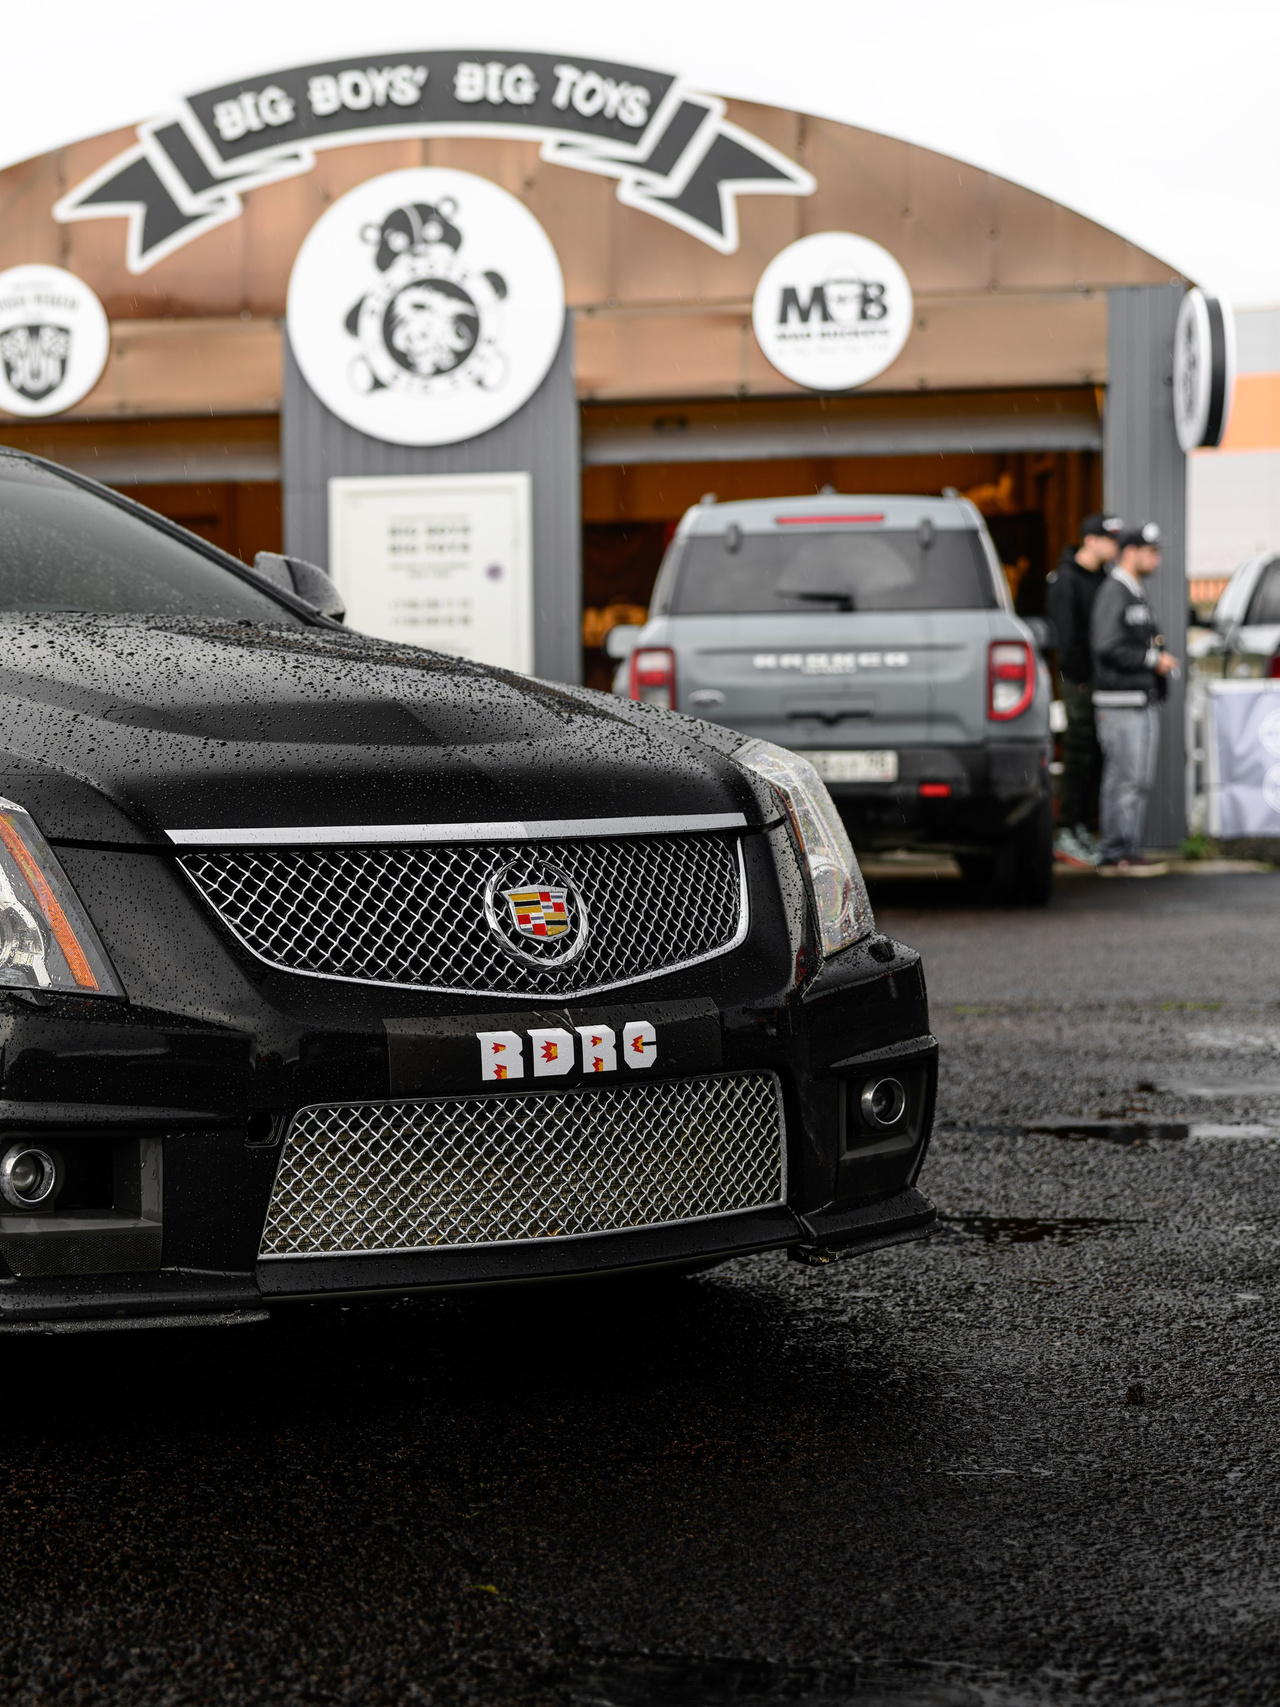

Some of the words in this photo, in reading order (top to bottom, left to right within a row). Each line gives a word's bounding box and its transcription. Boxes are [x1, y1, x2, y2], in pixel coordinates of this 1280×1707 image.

[213, 86, 296, 141] BIG
[308, 65, 428, 115] BOYS'
[454, 62, 539, 104] BIG
[554, 64, 650, 127] TOYS
[476, 1020, 657, 1081] RDRC
